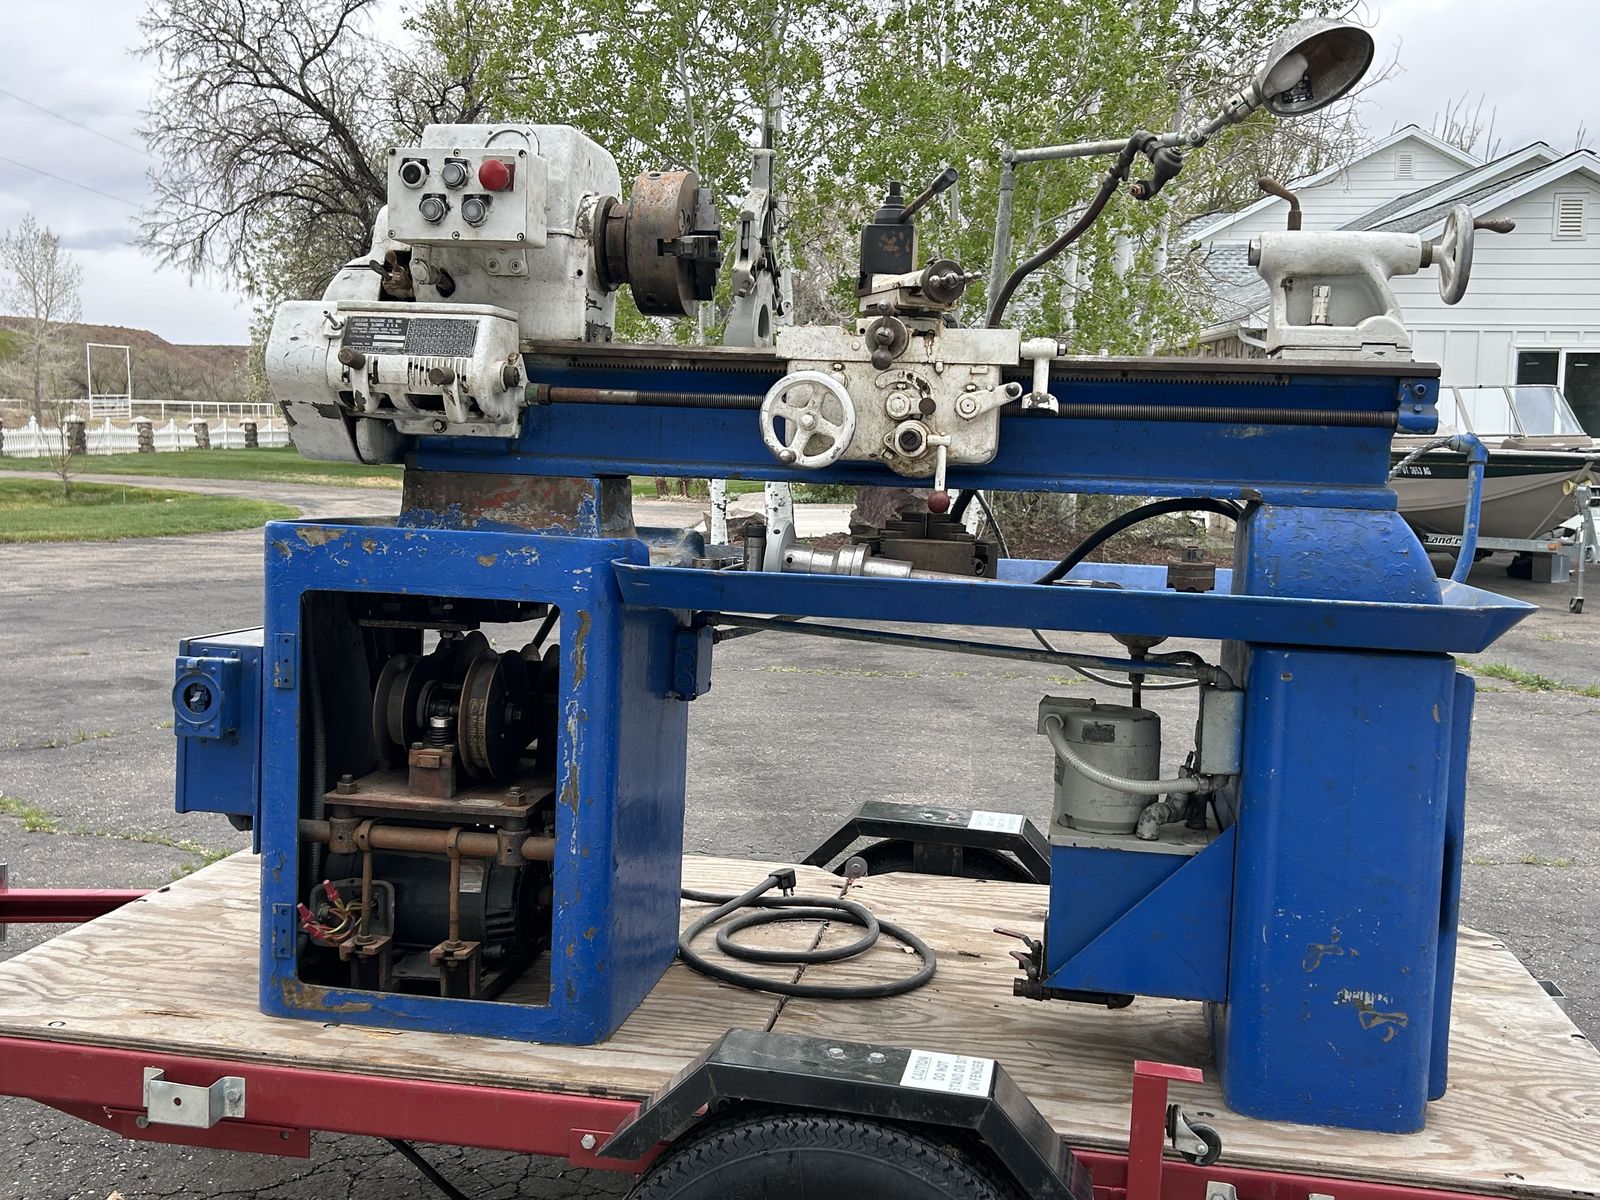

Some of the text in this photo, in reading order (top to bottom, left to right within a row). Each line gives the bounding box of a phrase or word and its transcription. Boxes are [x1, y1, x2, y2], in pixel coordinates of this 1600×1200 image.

[911, 1055, 930, 1080] CAUTION
[933, 1060, 949, 1081] DO NOT
[953, 1064, 966, 1073] OR
[967, 1060, 985, 1091] ON FENDER
[948, 1073, 964, 1091] STAND
